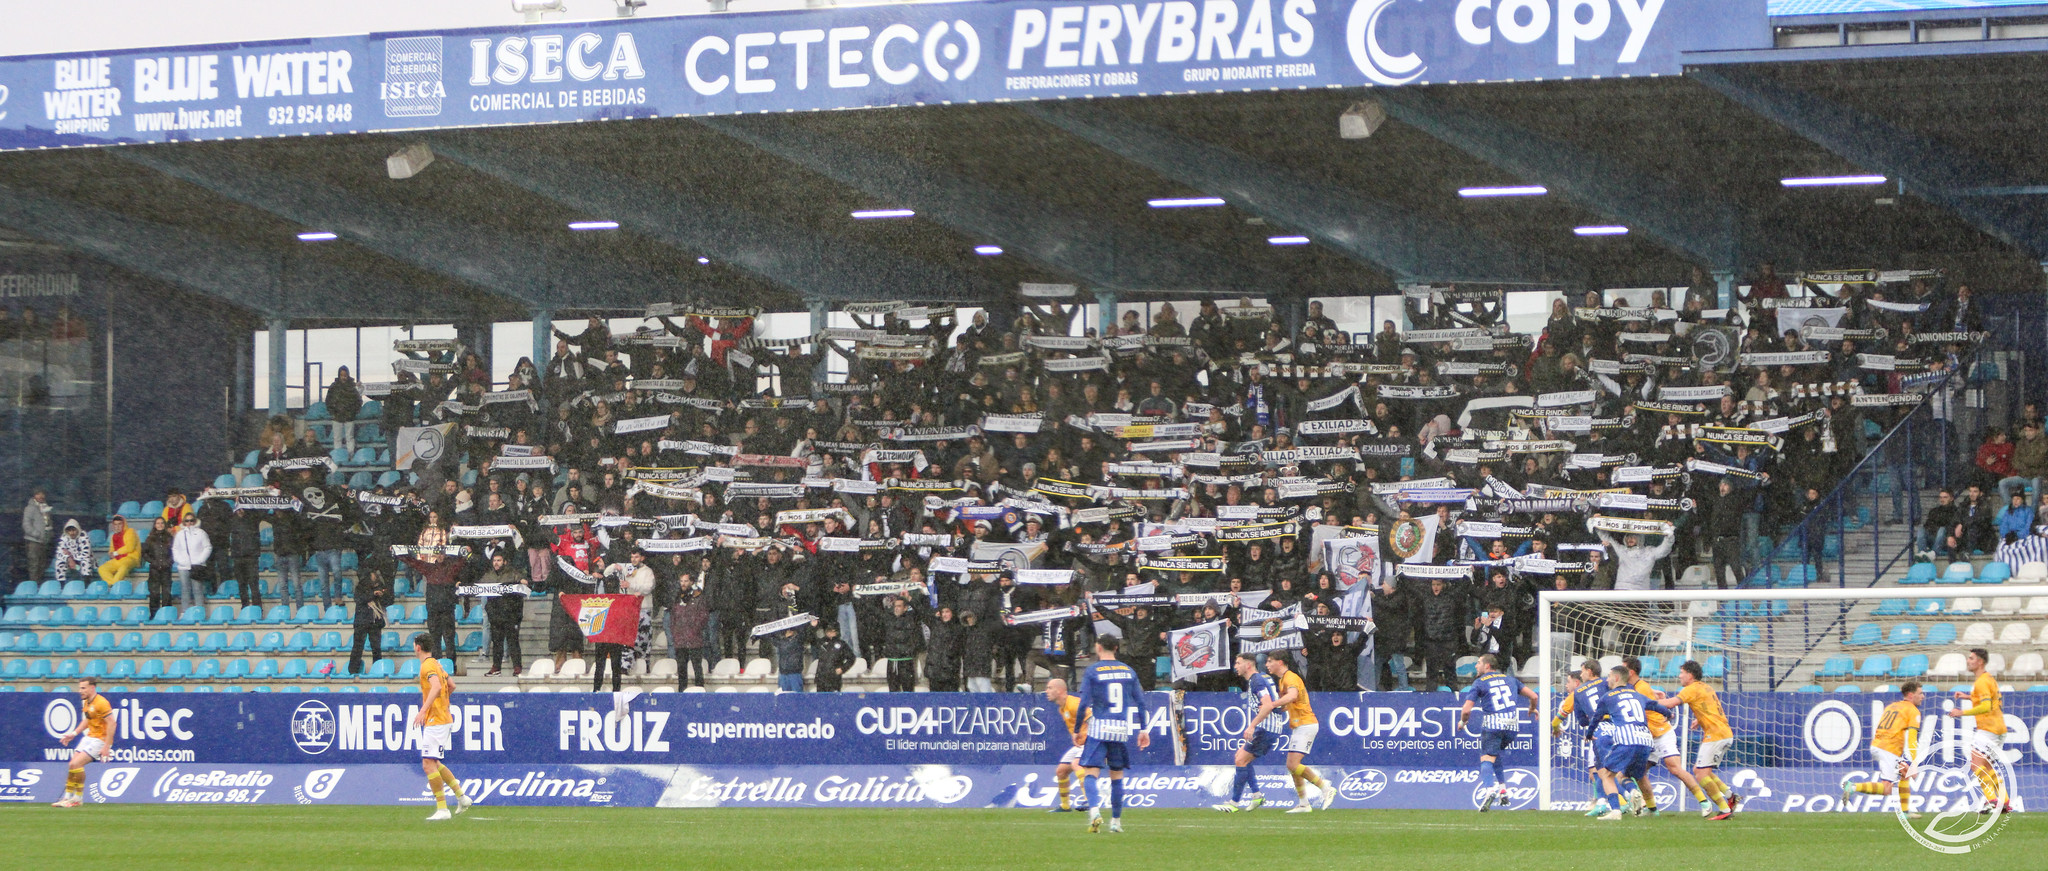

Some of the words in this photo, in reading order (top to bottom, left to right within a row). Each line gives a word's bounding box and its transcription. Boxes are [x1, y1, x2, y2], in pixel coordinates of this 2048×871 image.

[1007, 0, 1317, 70] PERYBRAS
[1454, 0, 1660, 66] copy
[391, 52, 437, 63] COMERCIAL
[470, 32, 645, 87] ISECA
[55, 57, 110, 90] BLUE
[135, 56, 218, 102] BLUE
[234, 49, 353, 99] WATER
[390, 65, 401, 75] DE
[403, 63, 437, 74] BEBIDAS
[1183, 69, 1218, 83] GRUPO
[1223, 66, 1271, 81] MORANTE
[1274, 63, 1317, 78] PEREDA
[380, 80, 446, 100] ISECA
[1006, 75, 1092, 91] PERFORACIONES
[1094, 76, 1102, 87] Y
[1103, 72, 1138, 86] OBRAS
[44, 88, 122, 120] WATER
[470, 91, 554, 112] COMERCIAL
[559, 90, 577, 108] DE
[582, 87, 647, 107] BEBIDAS
[55, 117, 110, 135] SHIPPING
[135, 106, 241, 132] www.bws.net
[268, 108, 294, 126] 932
[297, 106, 323, 125] 954
[327, 104, 352, 123] 848
[1916, 332, 1968, 343] UNIONISTAS
[1707, 432, 1731, 440] NUNCA
[1741, 434, 1766, 442] RINDE
[271, 458, 323, 468] UNIONISTAS
[1037, 483, 1058, 493] NUNCA
[1066, 488, 1085, 496] RINDE
[1225, 531, 1250, 539] NUNCA
[1260, 529, 1282, 538] RINDE
[1150, 561, 1176, 569] NUNCA
[463, 584, 514, 595] UNIONISTAS
[1316, 616, 1352, 626] MEMORIAM
[1108, 682, 1123, 713] 9
[1490, 685, 1516, 711] 22
[1617, 698, 1645, 723] 20
[1877, 710, 1899, 730] 20
[339, 704, 505, 751] MECAPER
[560, 710, 670, 752] FROIZ
[687, 718, 835, 743] supermercado
[886, 740, 895, 750] El
[897, 739, 919, 750] líder
[920, 739, 959, 750] mundial
[976, 741, 1010, 752] pizarra
[1012, 740, 1045, 750] natural
[1363, 738, 1384, 749] Los
[1386, 739, 1435, 752] expertos
[1455, 738, 1482, 749] Pied
[1504, 739, 1533, 750] tural
[107, 771, 128, 791] 8
[178, 770, 274, 787] esRadio
[312, 773, 333, 793] 8
[1340, 776, 1384, 794] ibsa
[1395, 770, 1480, 783] CONSERVAS
[89, 782, 106, 804] BIERZO
[166, 788, 223, 803] Bierzo
[225, 789, 266, 803] 98.7
[294, 785, 312, 804] BIERZO
[683, 775, 807, 803] Estrella
[813, 775, 927, 803] Galicia
